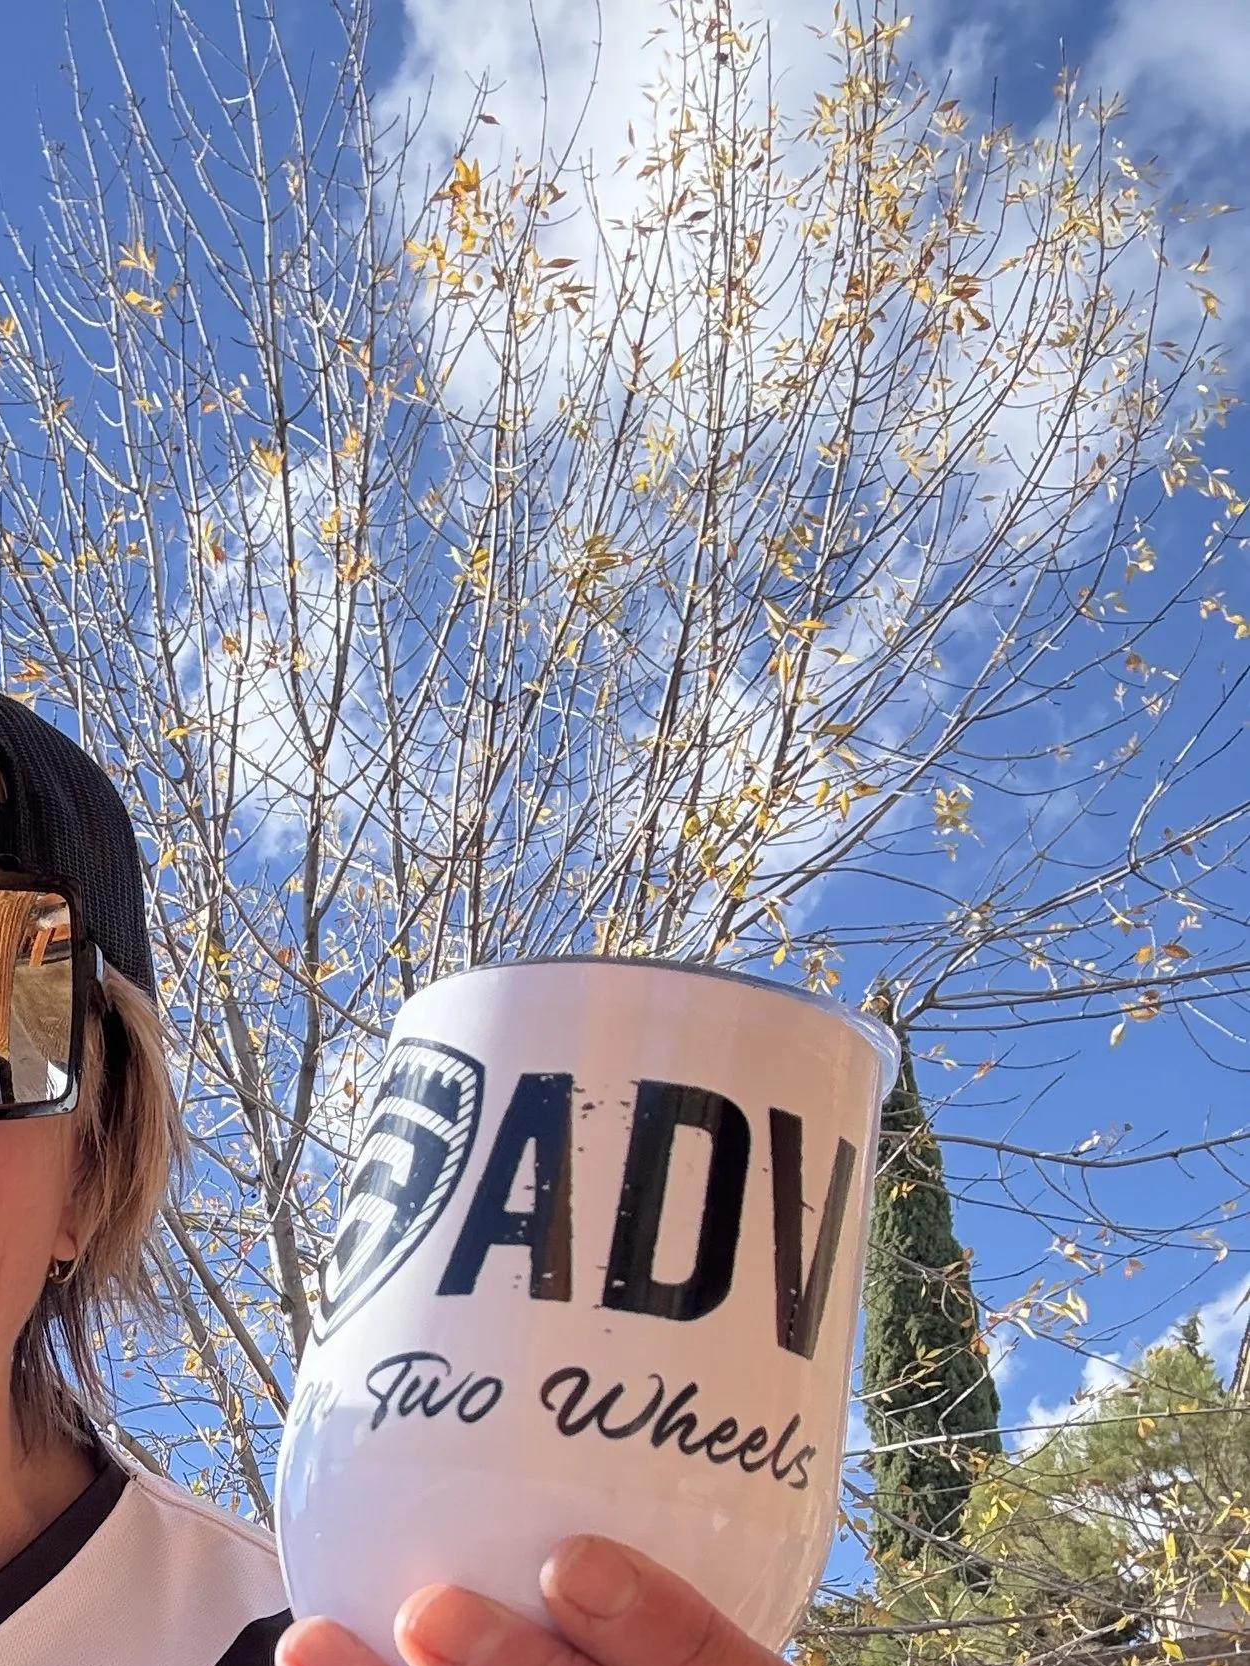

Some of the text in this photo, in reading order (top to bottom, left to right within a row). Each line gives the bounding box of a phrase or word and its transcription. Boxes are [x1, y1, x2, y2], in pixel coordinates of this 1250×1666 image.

[436, 1072, 857, 1361] ADV
[366, 1351, 504, 1431] Two
[541, 1367, 817, 1491] Wheels
